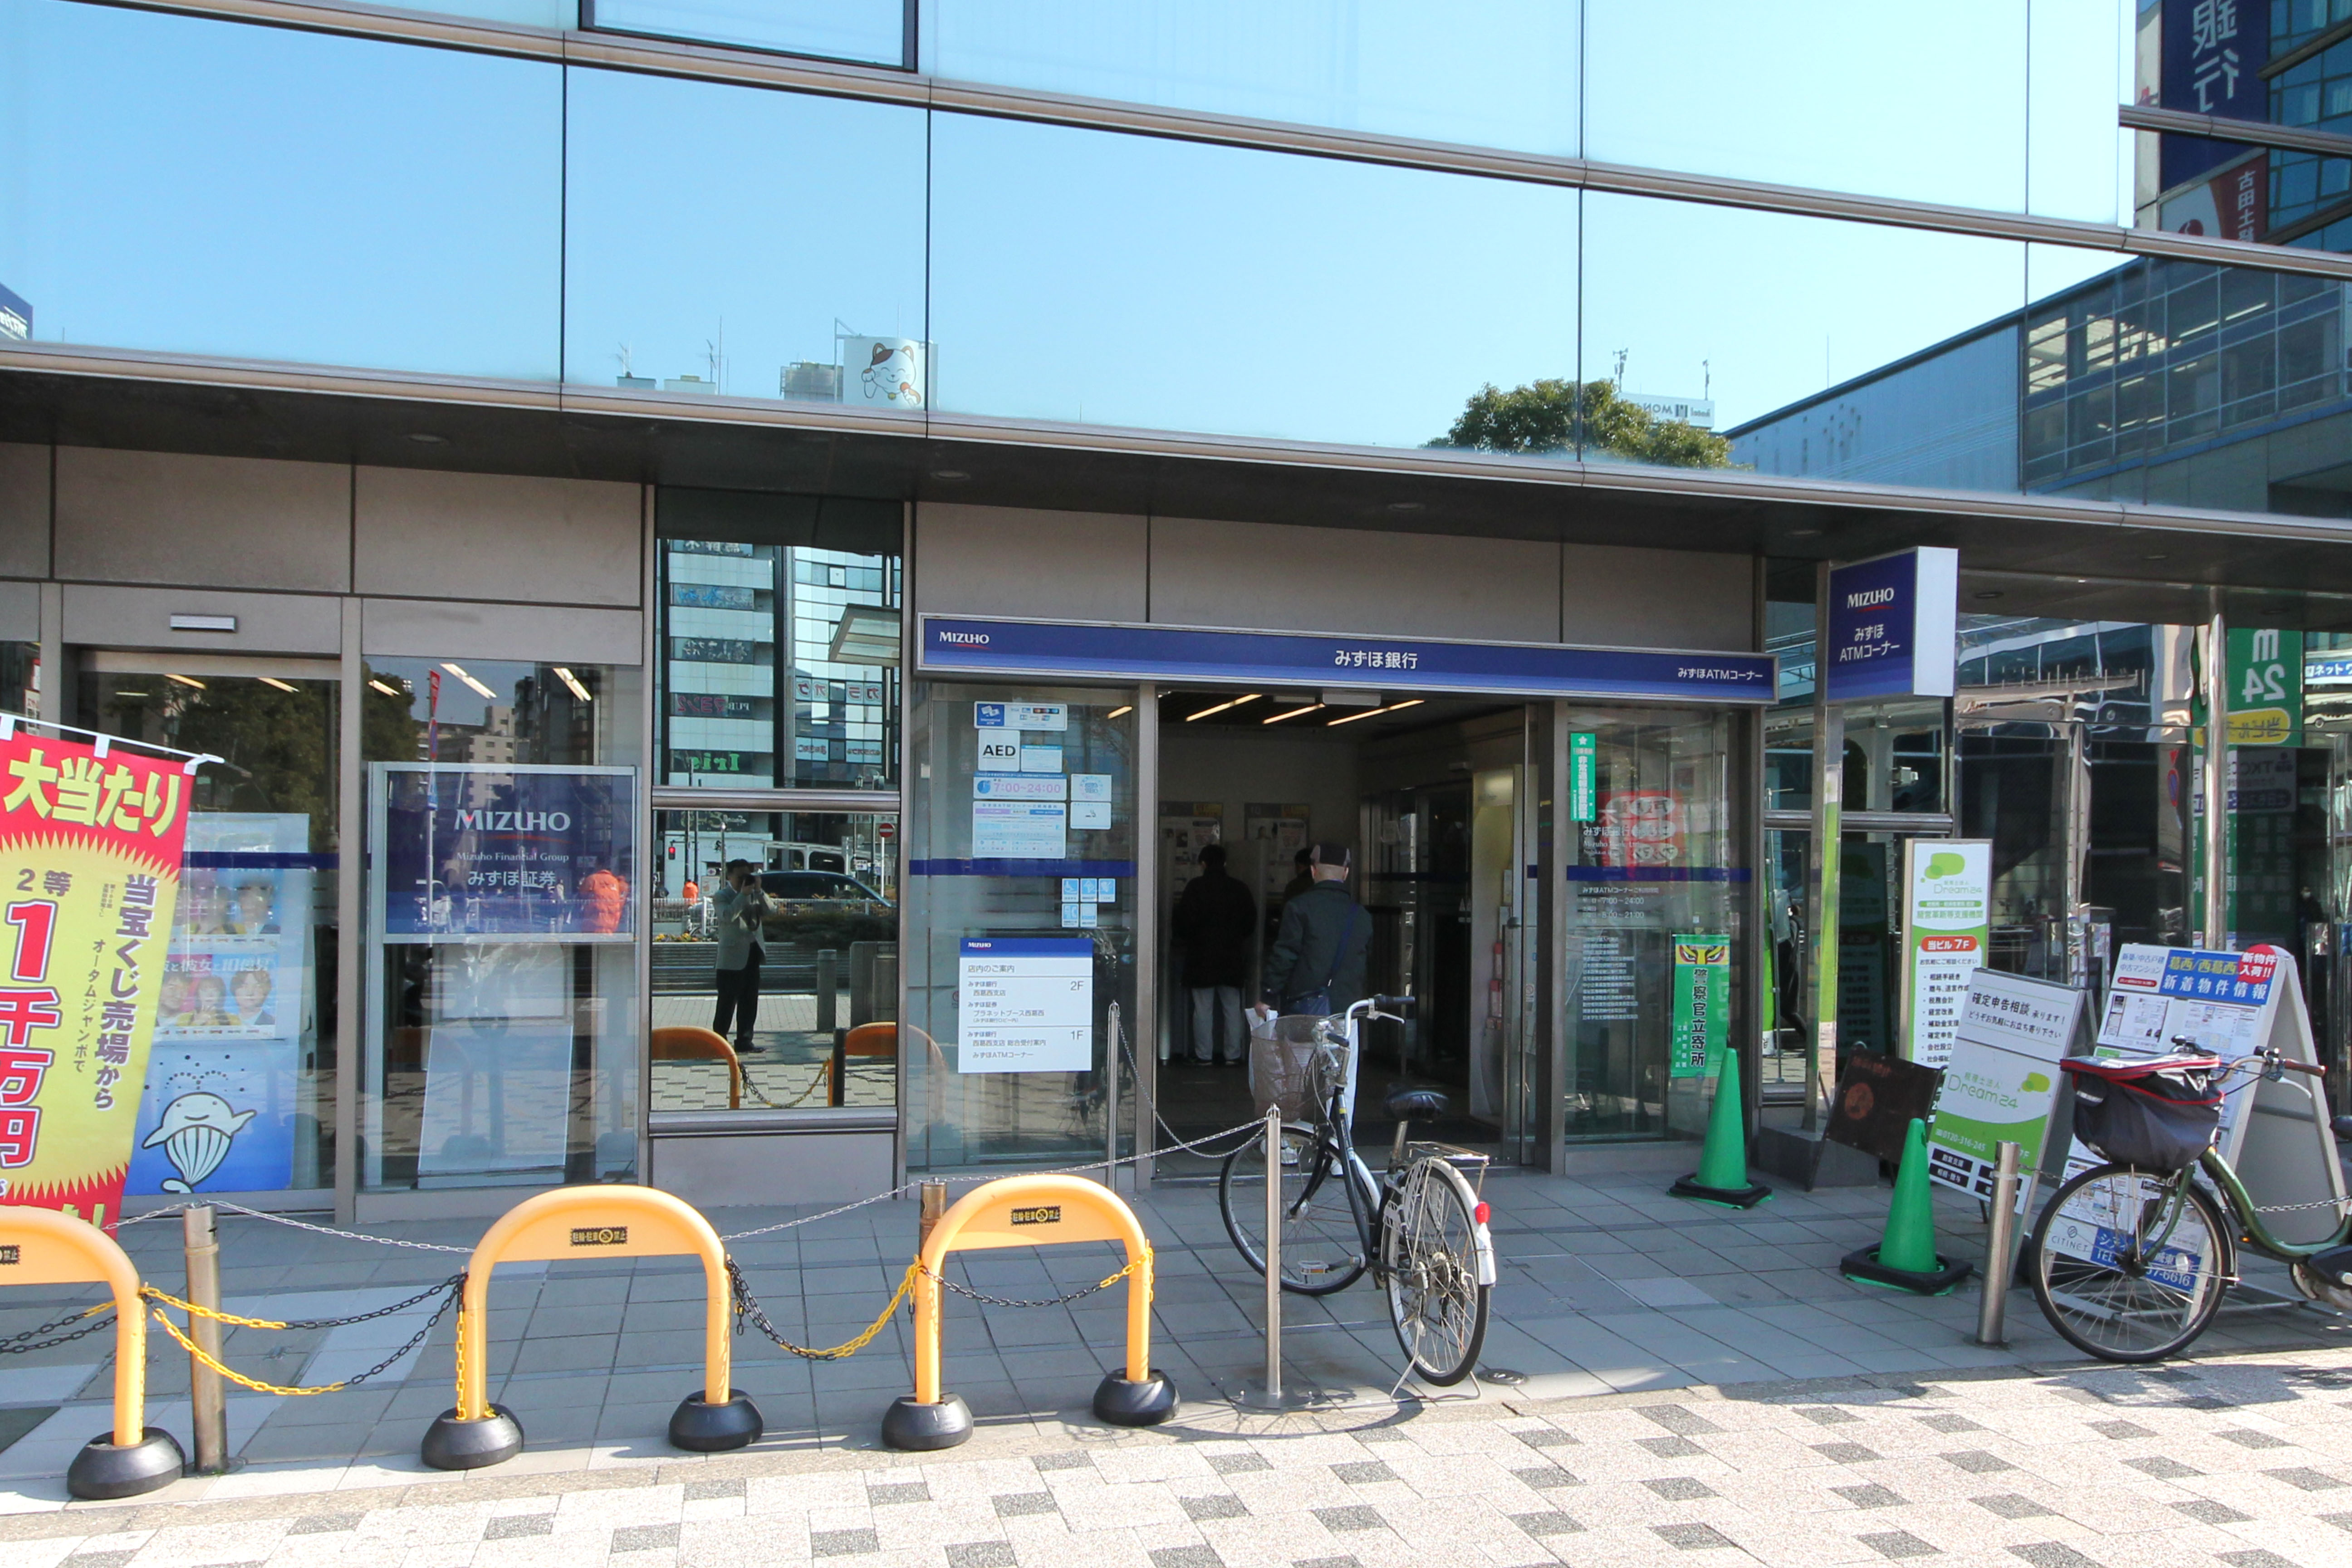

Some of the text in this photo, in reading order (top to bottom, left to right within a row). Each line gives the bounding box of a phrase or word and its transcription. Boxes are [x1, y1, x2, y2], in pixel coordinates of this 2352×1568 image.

[1847, 587, 1895, 609] MIZUHO
[939, 631, 990, 644] MIZUHO
[1854, 624, 1884, 642] みずほ
[1334, 650, 1418, 670] みずほ銀行
[1840, 641, 1900, 662] ATMコーナー
[1677, 667, 1764, 681] みずほATMコーナー
[982, 745, 1016, 757] AED
[3, 748, 181, 838] 大当たり
[455, 809, 571, 831] MIZUHO
[457, 852, 569, 863] Mizuho Financial Group
[16, 867, 73, 897] 2等
[468, 871, 556, 887] みずほ証券
[1927, 939, 1970, 951] 当ビル 7F
[2240, 952, 2277, 965] 新物件
[967, 965, 1015, 973] 店内のご案内
[94, 873, 158, 1112] 当宝くじ売場から
[1070, 980, 1084, 991] 2F
[2162, 975, 2268, 1000] 新着物件情報
[73, 939, 106, 1073] オータムジャンボで
[1972, 991, 2032, 1016] 確定申告相談
[1690, 968, 1708, 1067] 警察官立寄所
[1968, 1010, 2062, 1039] どうぞお気軽にお立ち寄り下さい
[0, 901, 61, 1168] 1千万円
[1070, 1030, 1083, 1040] 1F
